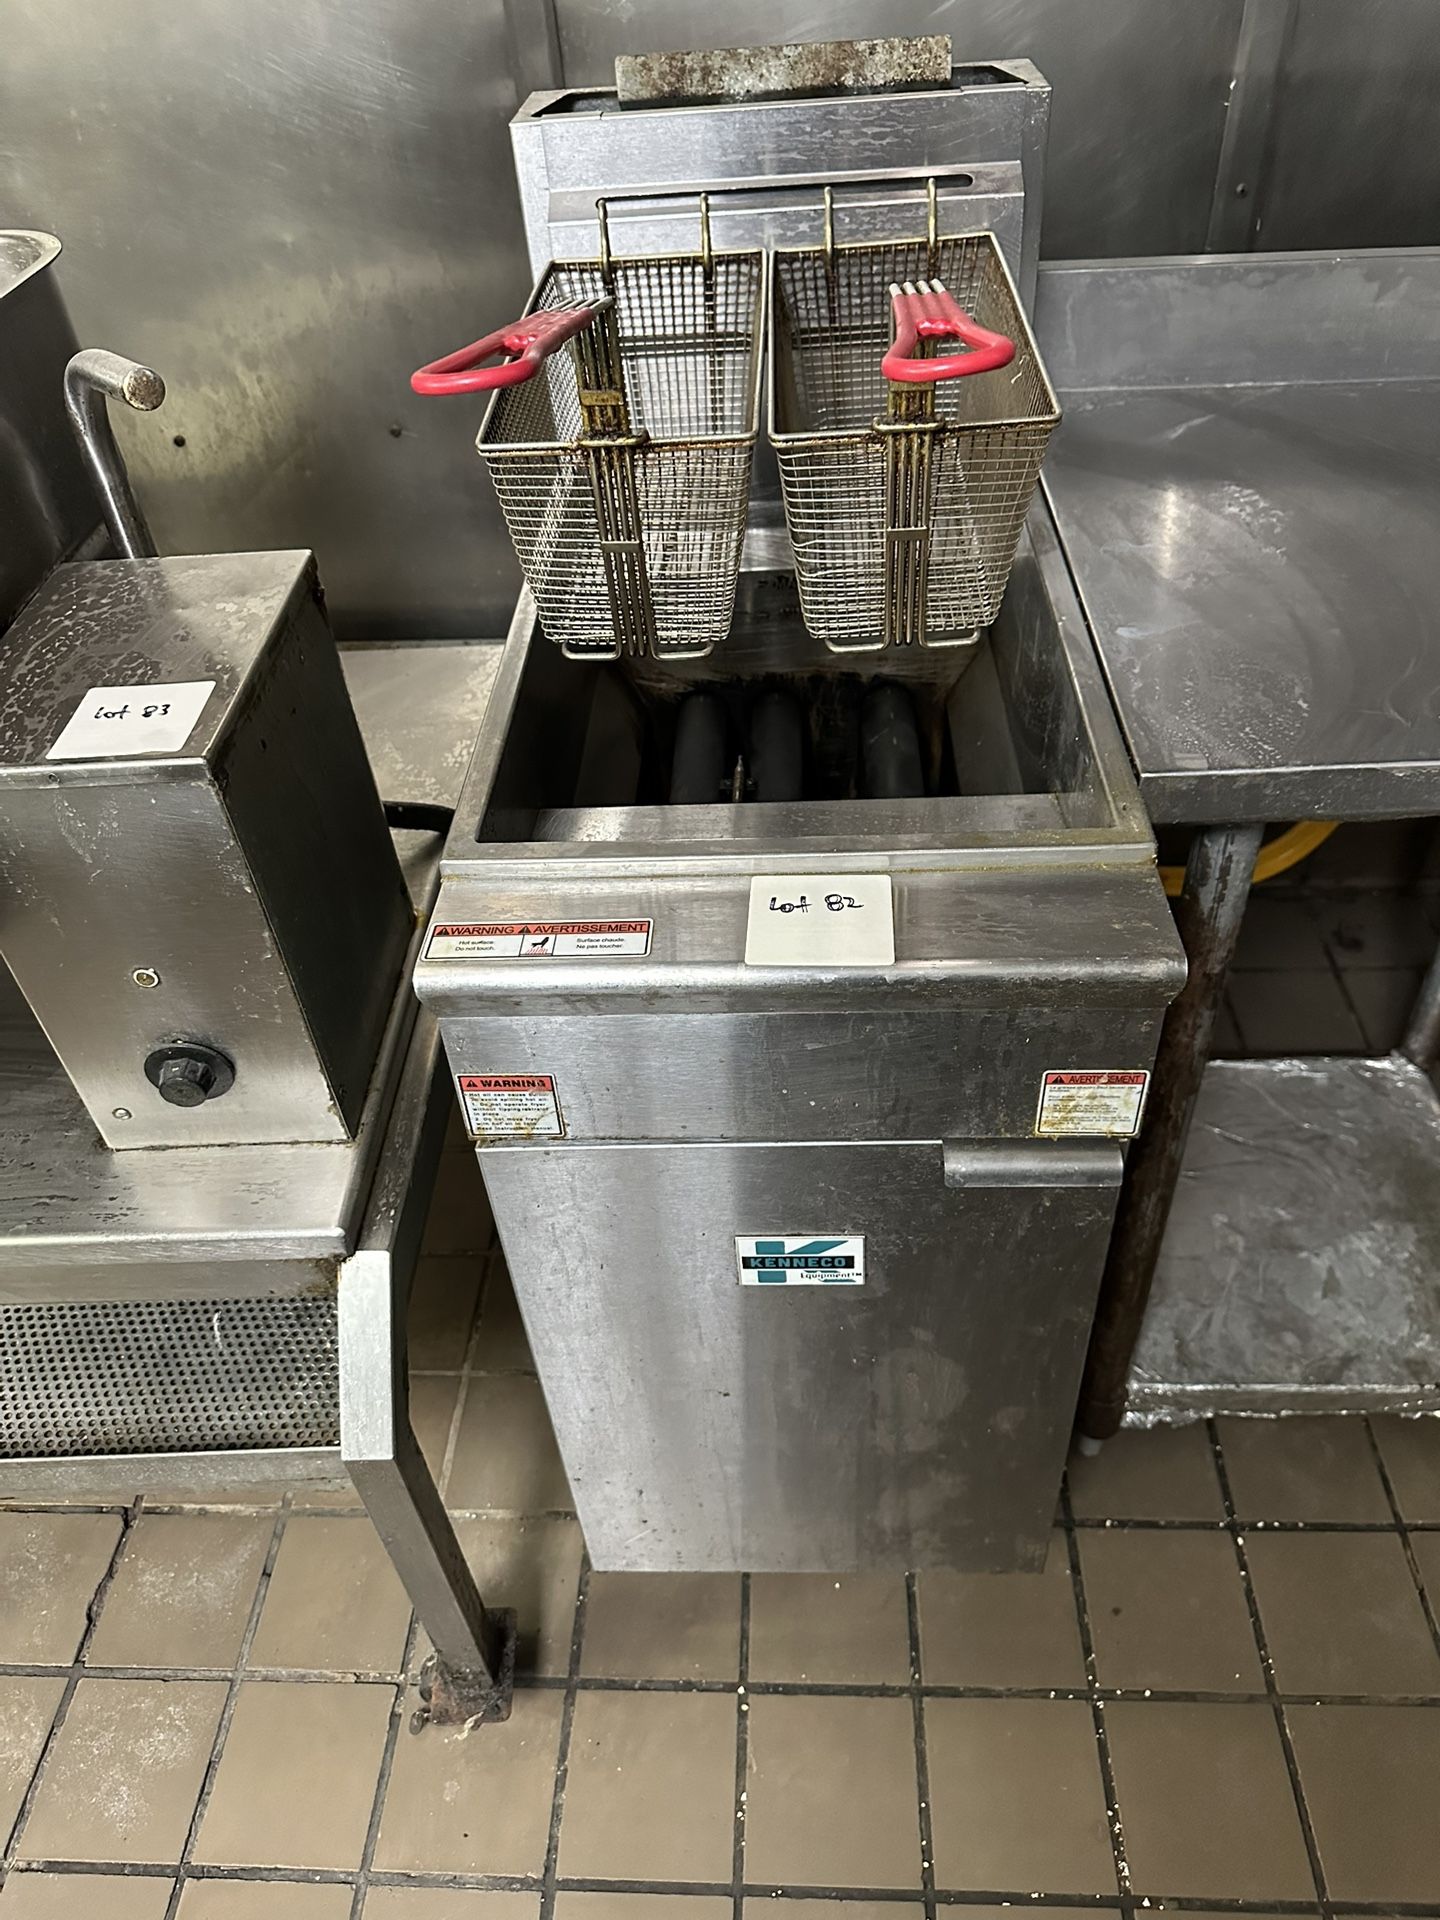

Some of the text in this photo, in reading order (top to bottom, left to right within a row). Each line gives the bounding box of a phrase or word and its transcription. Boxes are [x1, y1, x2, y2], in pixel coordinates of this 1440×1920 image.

[141, 703, 171, 718] 83
[769, 894, 864, 913] Lot 82
[450, 926, 515, 935] WARNING
[533, 923, 647, 933] AVERTISSEMENT
[480, 1079, 545, 1088] WARNING
[750, 1257, 846, 1268] KENNECO
